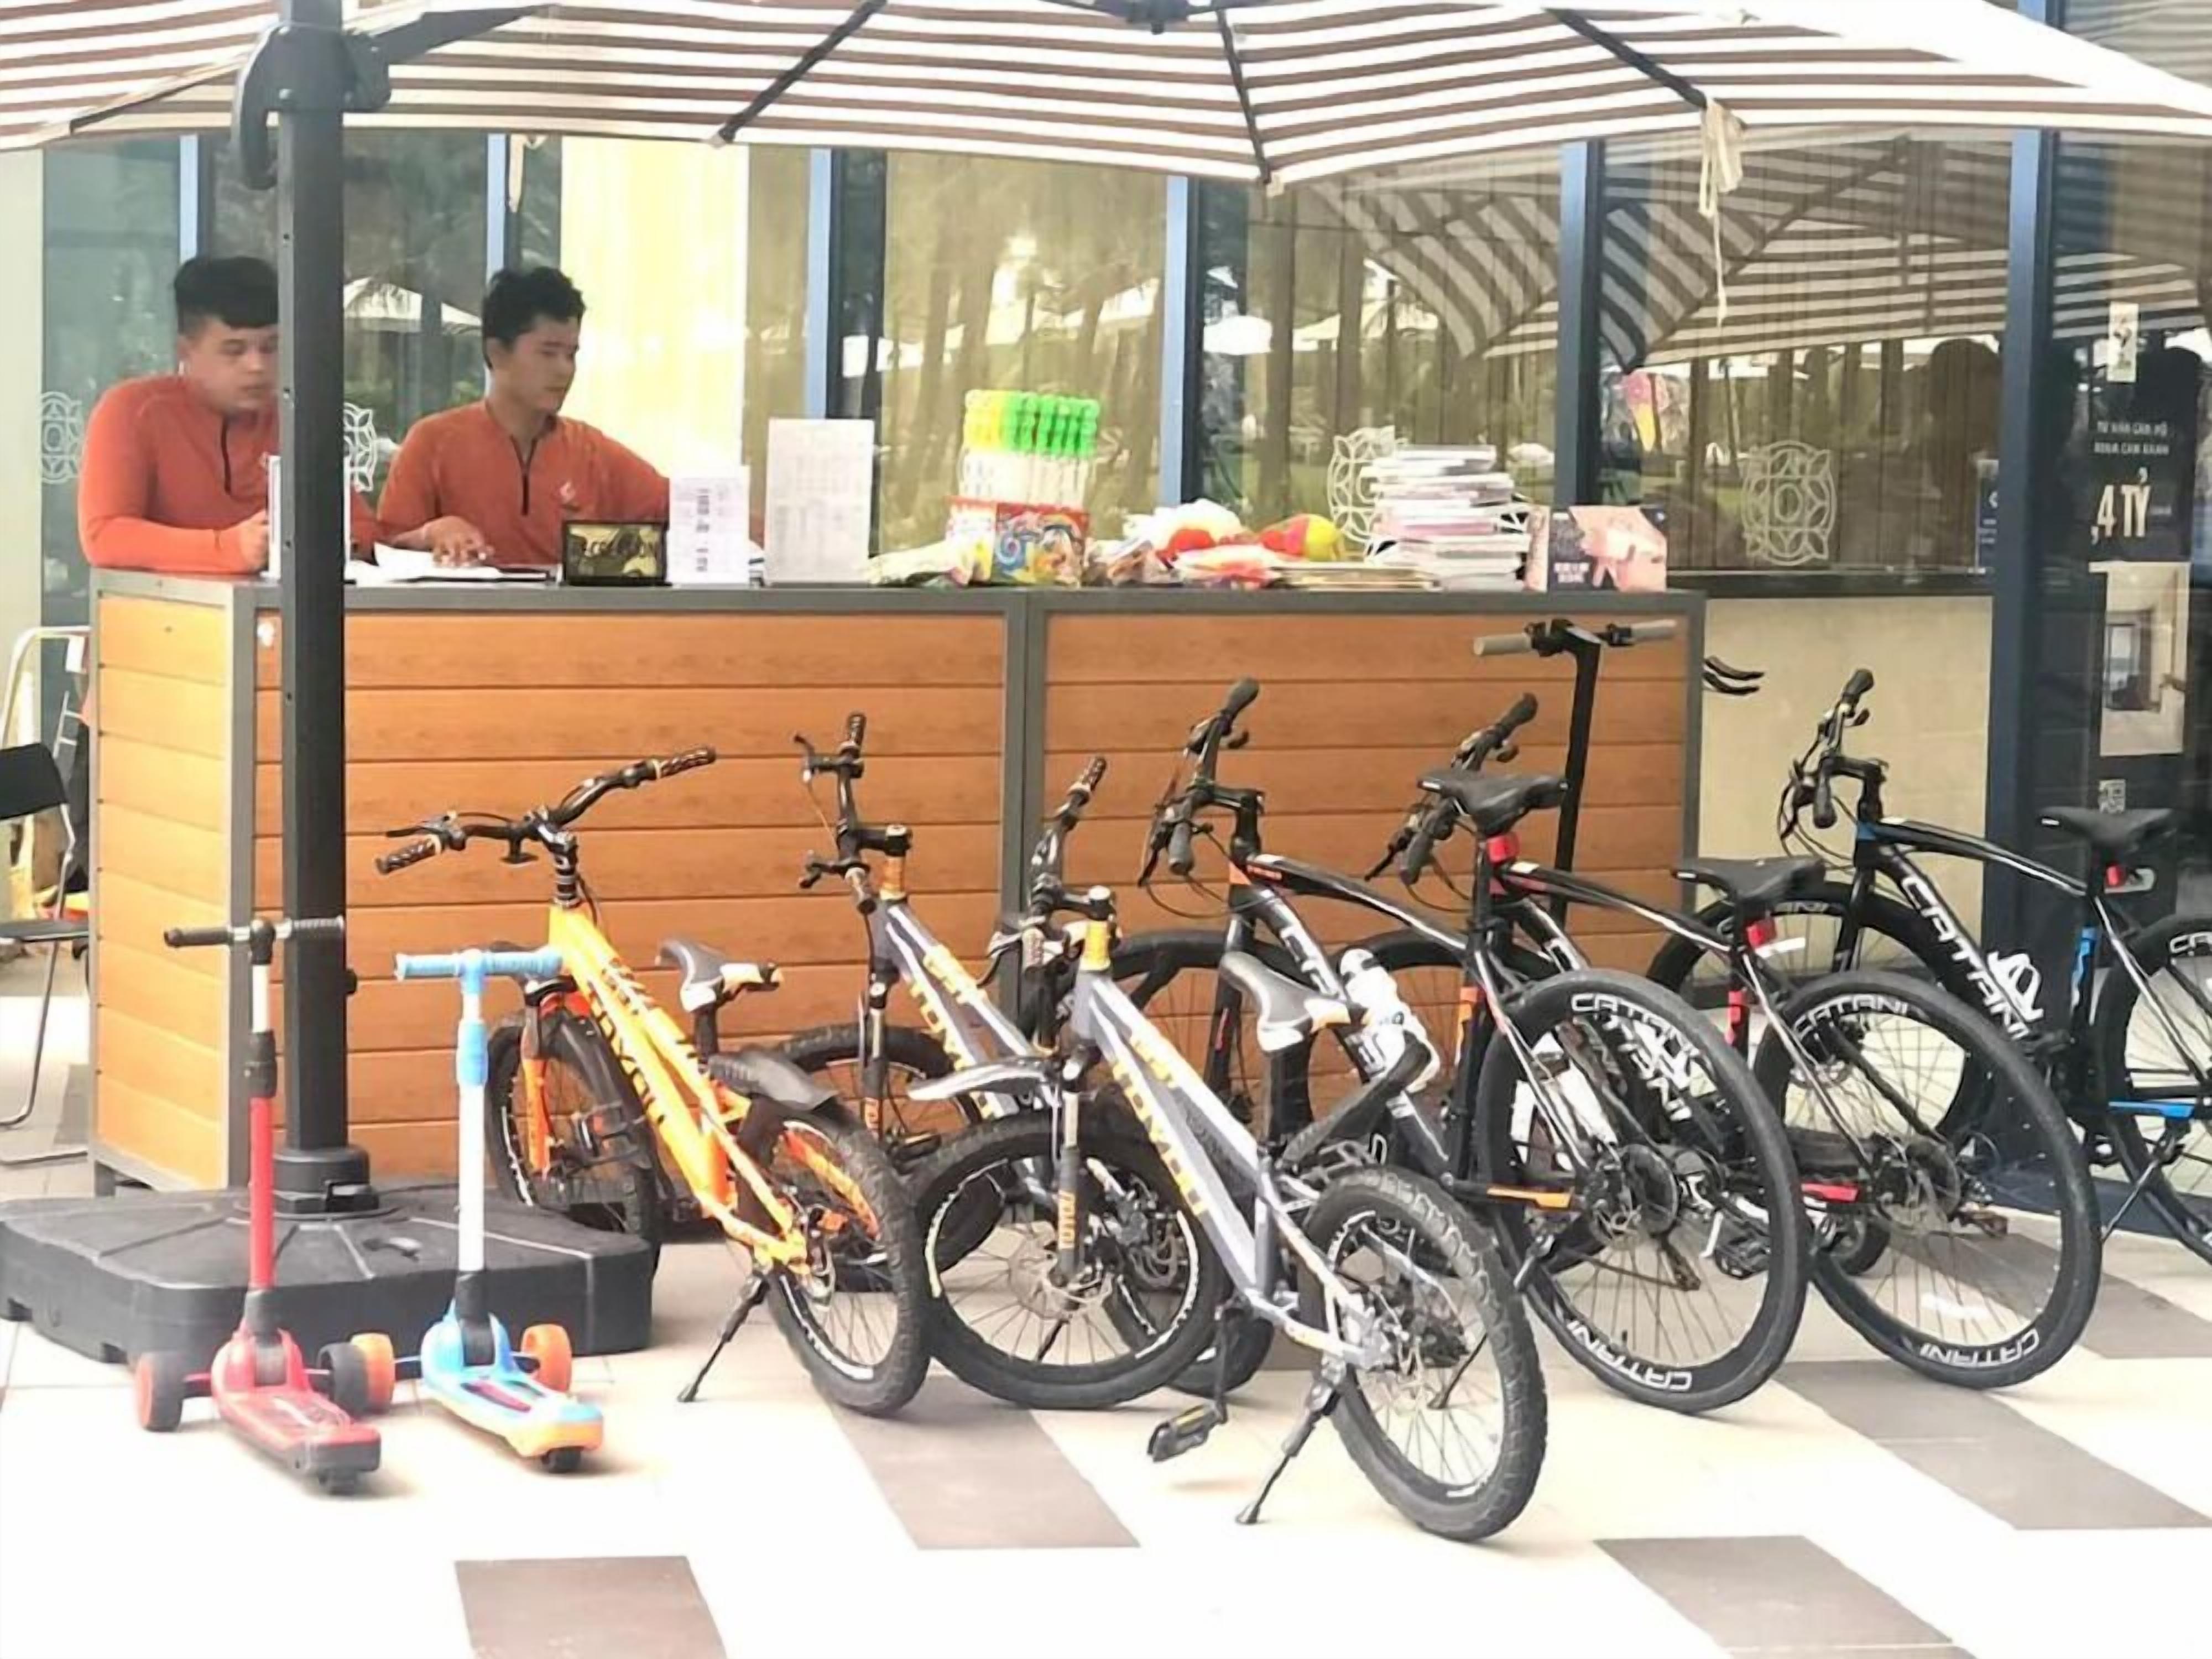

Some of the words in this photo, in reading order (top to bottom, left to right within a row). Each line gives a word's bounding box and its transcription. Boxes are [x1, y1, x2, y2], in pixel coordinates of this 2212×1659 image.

[1901, 877, 2030, 1040] CATANI
[1792, 993, 1908, 1041] CATANI
[1567, 1320, 1693, 1392] CATANI
[1919, 1328, 2039, 1368] CATANI
